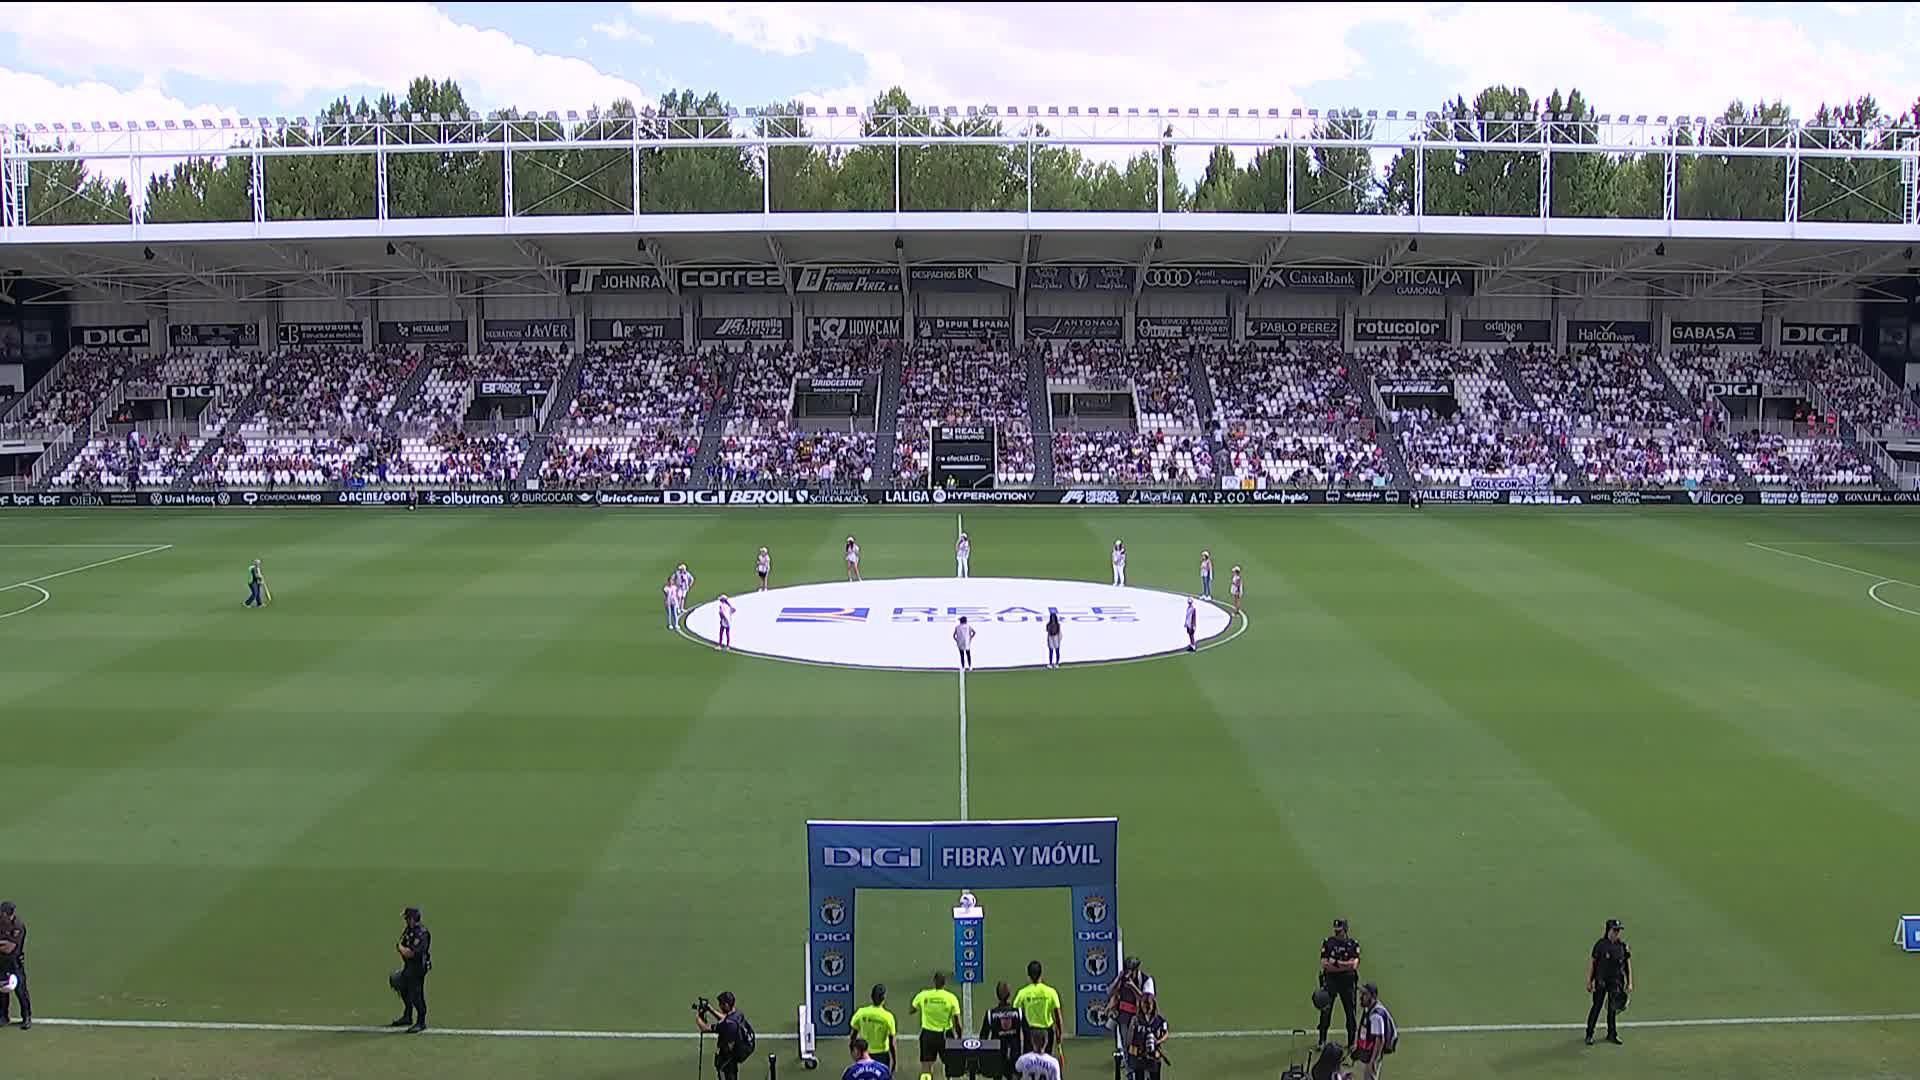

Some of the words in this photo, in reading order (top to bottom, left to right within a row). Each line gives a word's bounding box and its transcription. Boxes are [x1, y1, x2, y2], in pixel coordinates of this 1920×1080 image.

[681, 270, 785, 287] correa
[958, 268, 973, 279] BK
[1289, 270, 1355, 285] CaixaBank
[1381, 270, 1462, 288] OPTICALIA
[1397, 287, 1442, 295] GAMONAL
[1260, 323, 1297, 333] PABLO
[1300, 323, 1337, 333] PEREZ
[1357, 321, 1440, 334] rotucolor
[1673, 327, 1736, 339] GABASA
[83, 328, 149, 345] DIGI
[1783, 327, 1848, 342] DIGI
[171, 385, 221, 398] DIGI
[1709, 384, 1758, 396] DIGI
[165, 495, 184, 503] Ural
[298, 494, 321, 503] PARDO
[522, 493, 573, 502] BURGOCAR
[601, 493, 660, 503] BricoCentro
[663, 490, 726, 504] DIGI
[729, 490, 793, 504] BEROIL
[885, 490, 930, 503] LALIGA
[948, 492, 1027, 501] HYPERMOTION
[1418, 490, 1465, 499] TALLERES
[1467, 490, 1499, 499] PARDO
[1688, 490, 1745, 504] Villarce
[892, 606, 1137, 615] REALE
[823, 846, 922, 867] DIGI
[943, 846, 1009, 867] FIBRA
[1011, 846, 1026, 865] Y
[1032, 841, 1101, 866] MÓVIL
[814, 933, 850, 942] DIGI
[1078, 931, 1113, 940] DIGI
[814, 984, 850, 992] DIGI
[1080, 983, 1108, 992] DIG
